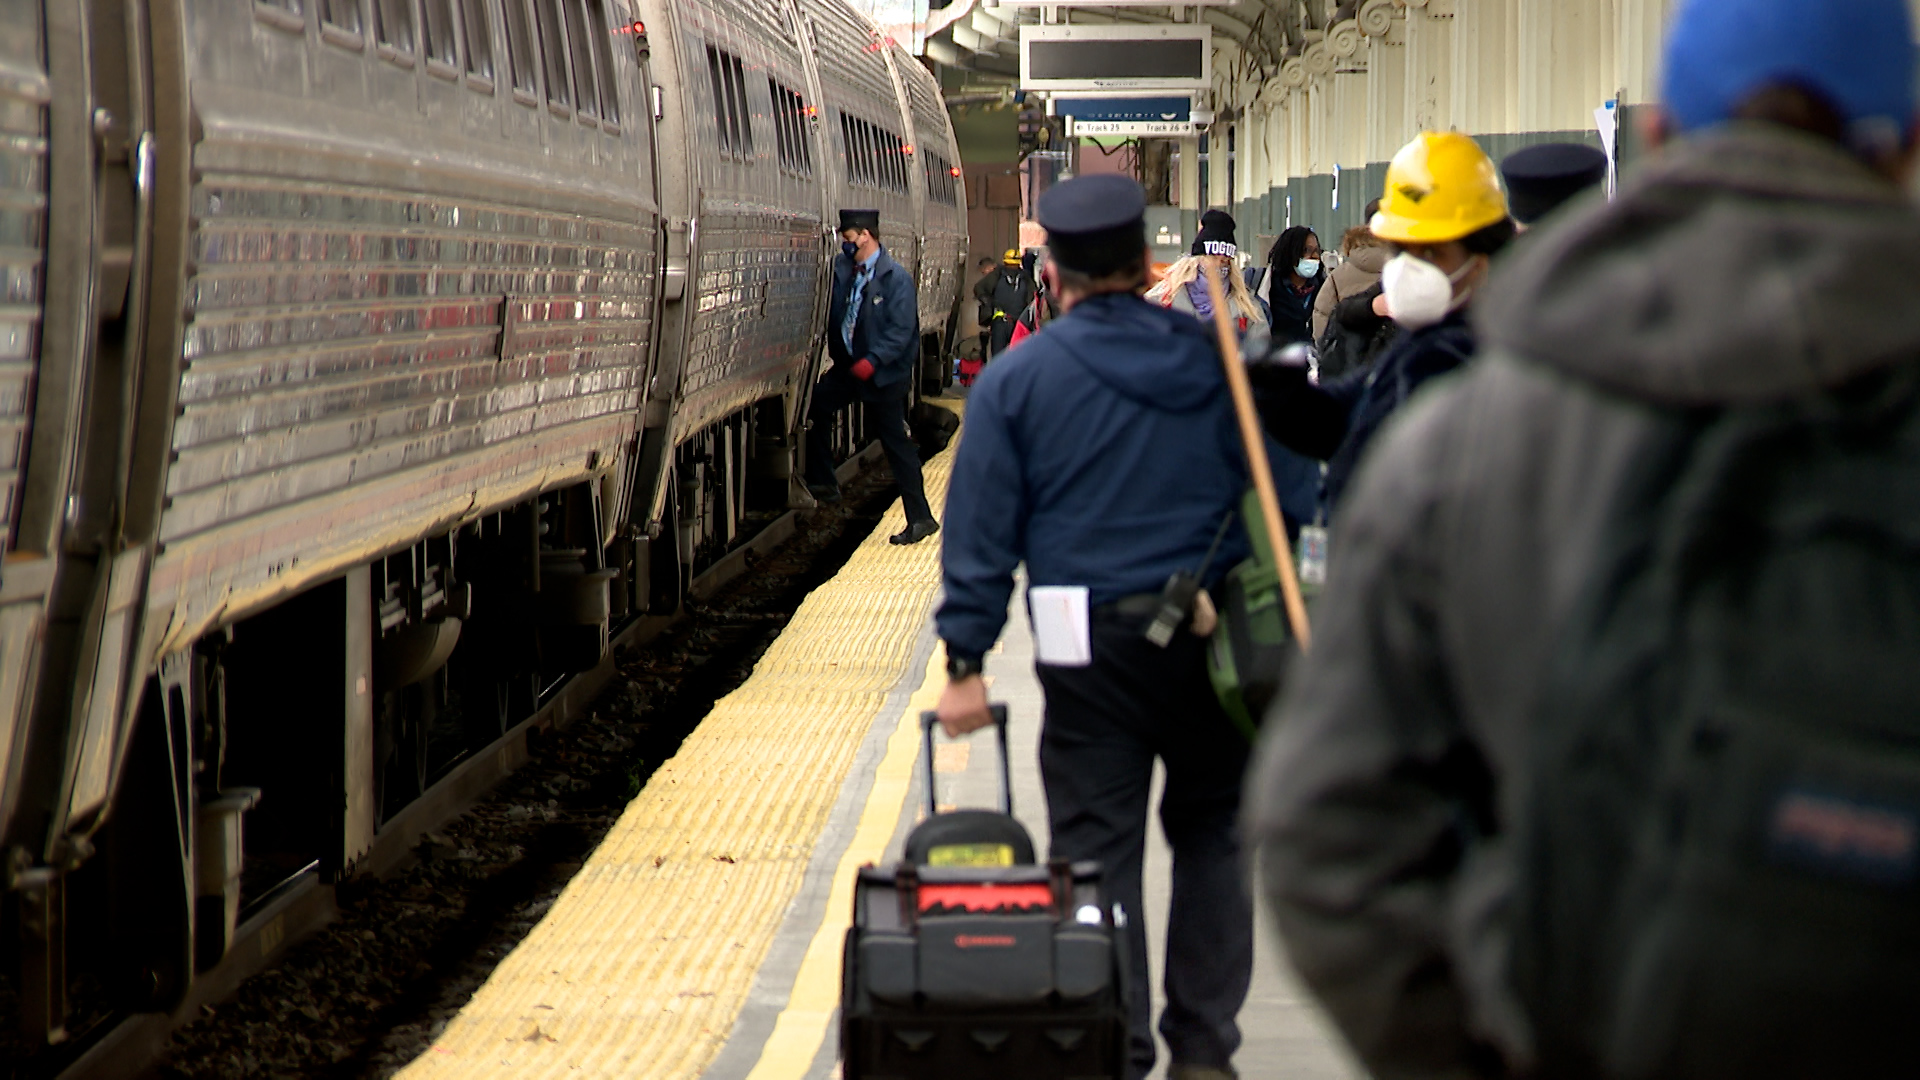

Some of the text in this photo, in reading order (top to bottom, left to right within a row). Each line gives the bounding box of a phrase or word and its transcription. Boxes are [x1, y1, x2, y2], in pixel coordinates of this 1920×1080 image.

[1086, 123, 1108, 132] Track
[1146, 123, 1167, 132] Track
[1169, 123, 1180, 132] 26
